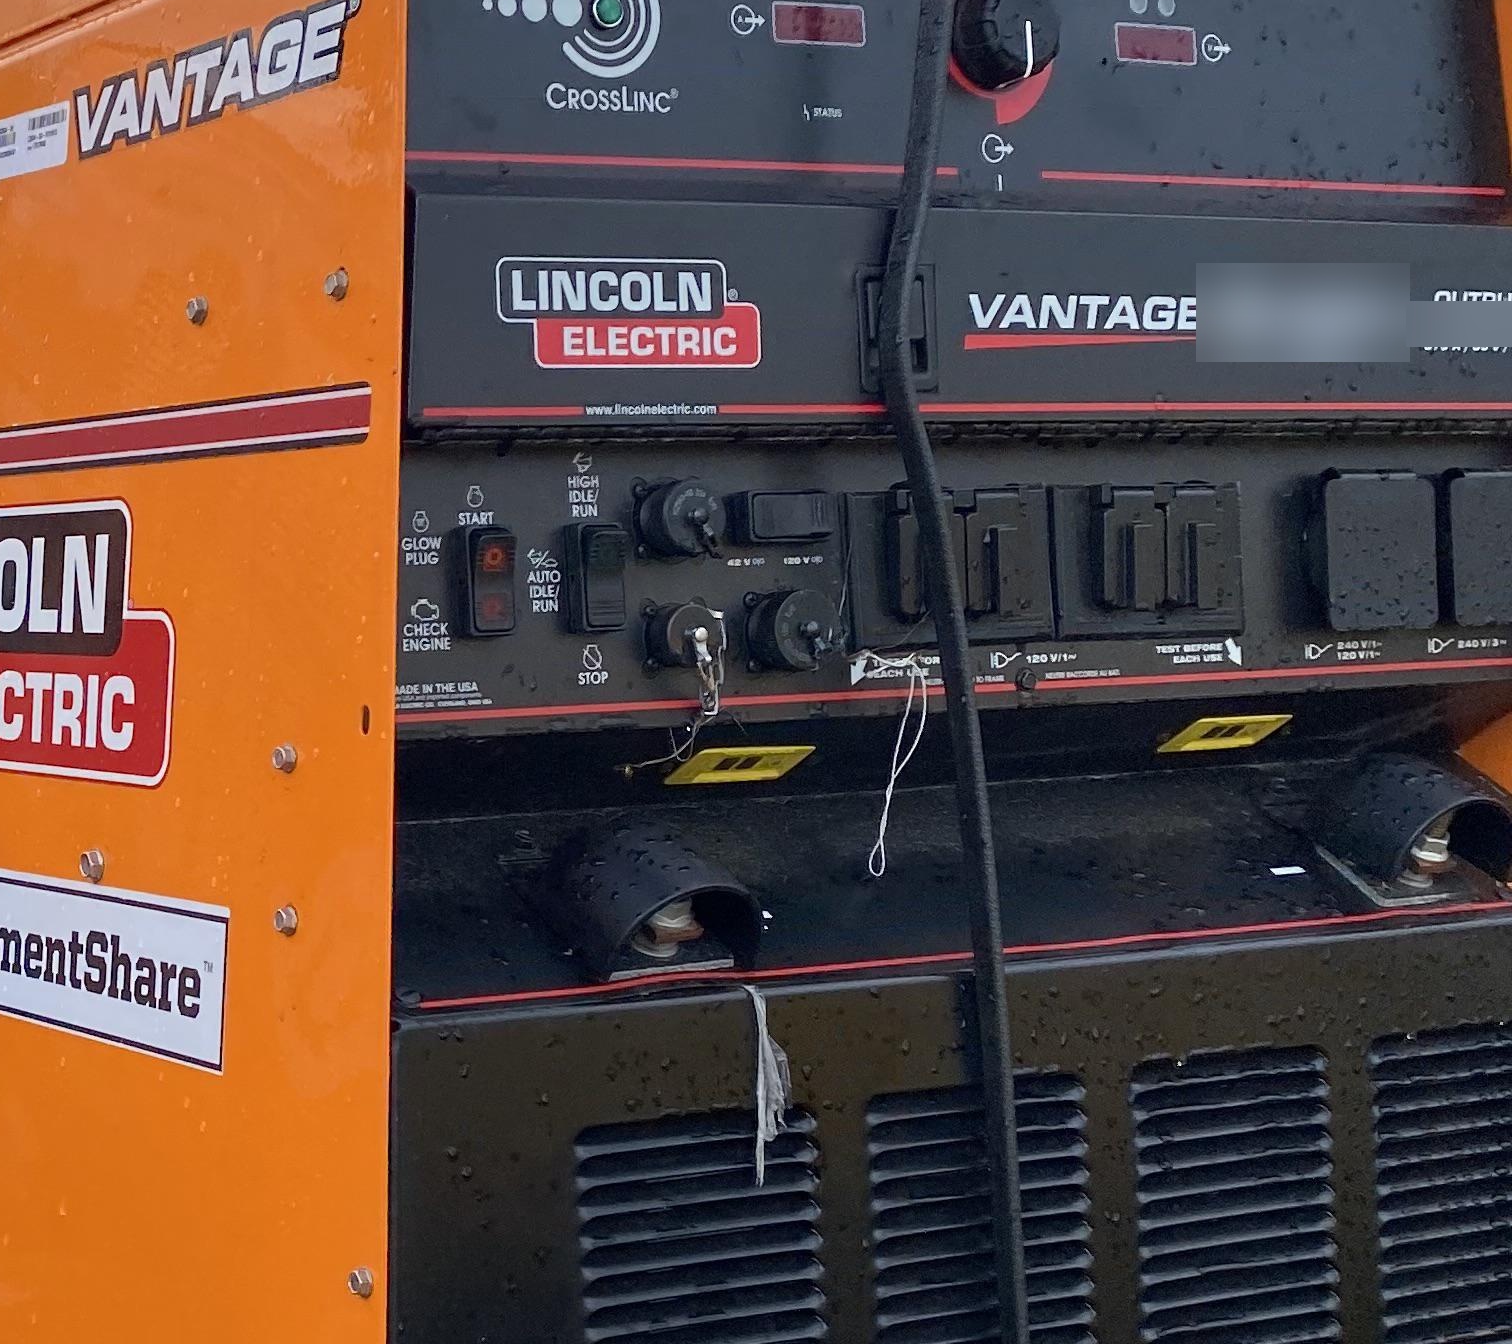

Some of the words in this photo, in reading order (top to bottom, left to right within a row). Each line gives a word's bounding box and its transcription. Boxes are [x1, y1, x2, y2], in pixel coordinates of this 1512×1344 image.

[74, 1, 348, 154] VANTAGE
[511, 269, 713, 313] LINCOLN
[562, 326, 738, 357] ELECTRIC
[585, 403, 718, 416] www.lincolnelectric.com
[567, 475, 601, 490] HIGH
[568, 490, 601, 505] IDLE/
[571, 504, 599, 518] RUN
[458, 511, 496, 526] START
[401, 536, 443, 552] GLOW
[405, 552, 440, 566] PLUG
[783, 557, 802, 565] 120
[526, 570, 562, 584] AUTO
[529, 584, 561, 600] IDLE/
[532, 598, 559, 613] RUN
[403, 622, 449, 638] CHECK
[402, 638, 452, 653] ENGINE
[1155, 644, 1181, 654] TEST
[1183, 642, 1224, 653] BEFORE
[1337, 641, 1359, 650] 240
[1457, 639, 1479, 649] 240
[1025, 655, 1049, 665] 120
[1173, 655, 1201, 664] EACH
[1202, 653, 1224, 662] USE
[1337, 650, 1357, 661] 120
[578, 671, 609, 685] STOP
[422, 683, 434, 694] IN
[435, 682, 456, 693] THE
[457, 681, 479, 692] USA
